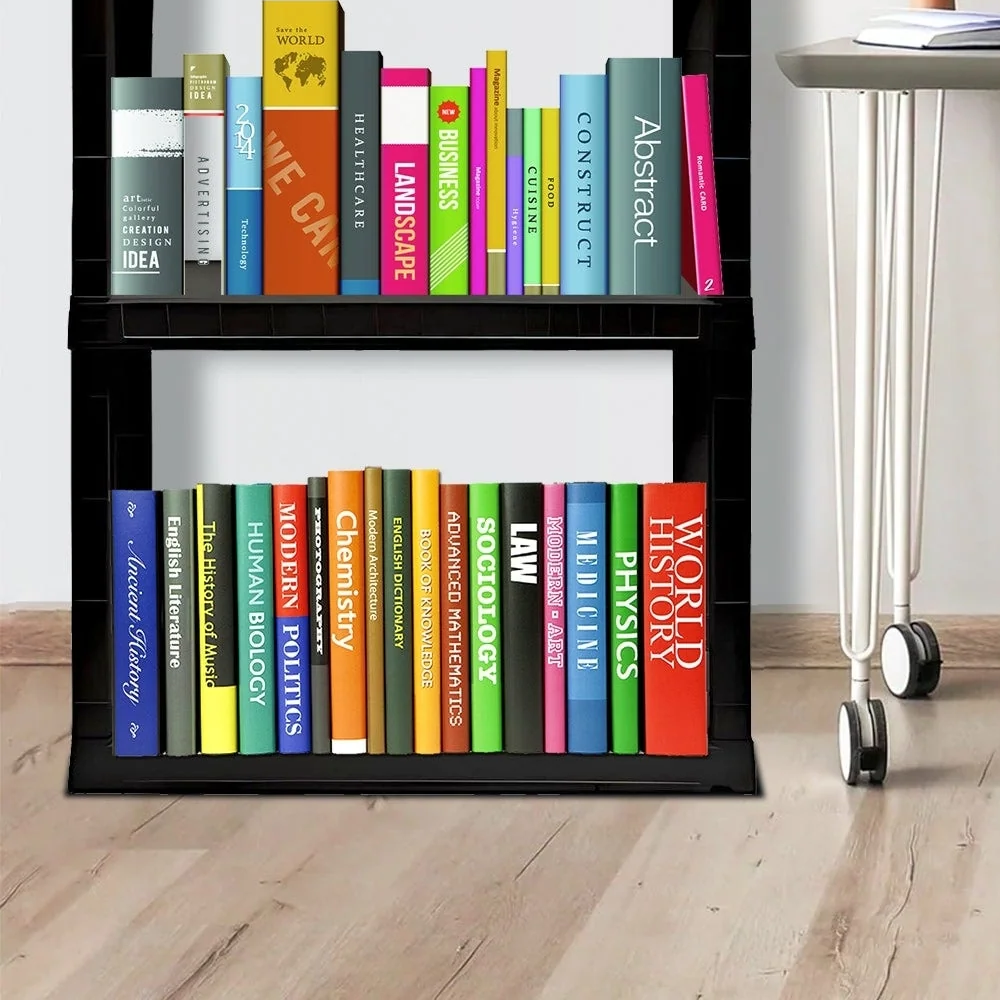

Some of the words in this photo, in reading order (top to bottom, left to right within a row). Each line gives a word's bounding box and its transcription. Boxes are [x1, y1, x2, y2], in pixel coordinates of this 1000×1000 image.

[276, 35, 325, 46] WORLD
[189, 91, 212, 100] IDEA
[442, 108, 456, 116] NEW
[493, 68, 502, 106] Magazine
[264, 130, 306, 196] WE
[354, 112, 364, 230] HEALTHCARE
[438, 129, 459, 210] BUSINESS
[547, 177, 555, 208] FOOD
[576, 111, 592, 268] CONSTRUCT
[633, 115, 662, 248] Abstract
[696, 155, 706, 189] Romantic
[122, 204, 160, 212] Colorful
[122, 214, 156, 222] gallery
[122, 225, 169, 234] CREATION
[197, 156, 210, 266] ADVERTISING
[394, 162, 416, 281] LANDSCAPE
[511, 208, 519, 246] Hygiene
[527, 166, 538, 235] CUISINE
[699, 190, 708, 212] CARD
[122, 238, 172, 247] DESIGN
[123, 250, 160, 269] IDEA
[239, 218, 249, 270] Technology
[704, 278, 714, 292] 2
[165, 515, 182, 579] English
[203, 521, 216, 553] The
[247, 522, 265, 606] HUMAN
[279, 501, 299, 610] MODERN
[368, 509, 378, 553] Modern
[393, 517, 403, 571] ENGLISH
[419, 529, 432, 570] BOOK
[447, 511, 462, 603] ADVANCED
[510, 523, 538, 585] LAW
[547, 516, 564, 608] MODERN
[127, 539, 147, 623] Ancient
[202, 557, 217, 617] History
[314, 507, 324, 655] PHOTOGRAPHY
[332, 510, 359, 651] Chemistry
[368, 555, 378, 621] Architecture
[393, 573, 404, 650] DICTIONARY
[420, 574, 433, 594] OF
[476, 517, 497, 685] SOCIOLOGY
[576, 531, 599, 671] MEDICINE
[649, 516, 675, 669] HISTORY
[673, 514, 704, 670] WORLD
[168, 584, 183, 669] Literature
[203, 620, 218, 640] of
[421, 597, 433, 689] KNOWLEDGE
[547, 622, 565, 669] ART
[615, 551, 639, 681] PHYSICS
[122, 624, 148, 707] History
[203, 642, 218, 688] Music
[248, 611, 267, 706] BIOLOGY
[282, 624, 303, 737] POLITICS
[448, 607, 463, 727] MATHEMATICS
